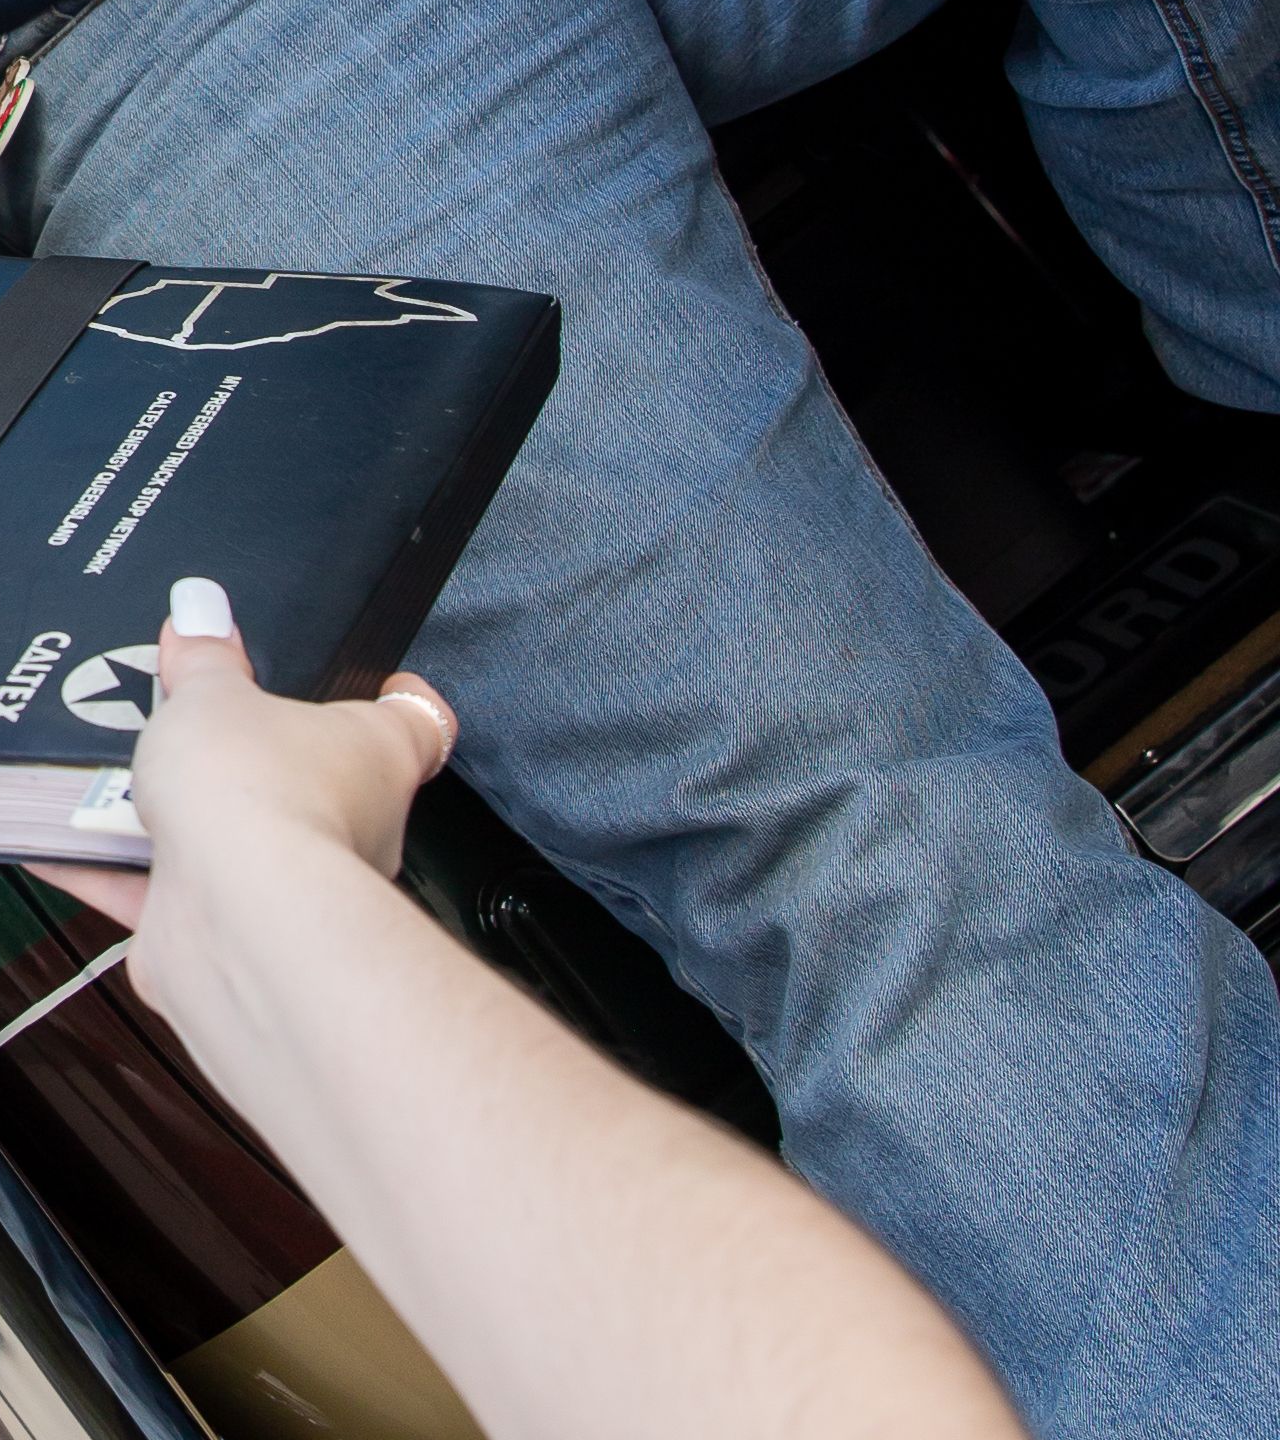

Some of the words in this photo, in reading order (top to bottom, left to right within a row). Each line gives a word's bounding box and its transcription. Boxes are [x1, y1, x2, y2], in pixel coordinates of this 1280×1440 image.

[218, 375, 243, 392] MY
[135, 390, 177, 430] CALTEX
[175, 390, 232, 450] PREFERRED
[104, 428, 149, 473] ENERGY
[147, 450, 190, 487] TRUCK
[47, 471, 117, 547] QUEENSLAND
[127, 486, 162, 518] STOP
[82, 516, 140, 575] NETWORK
[1030, 537, 1240, 699] ORD
